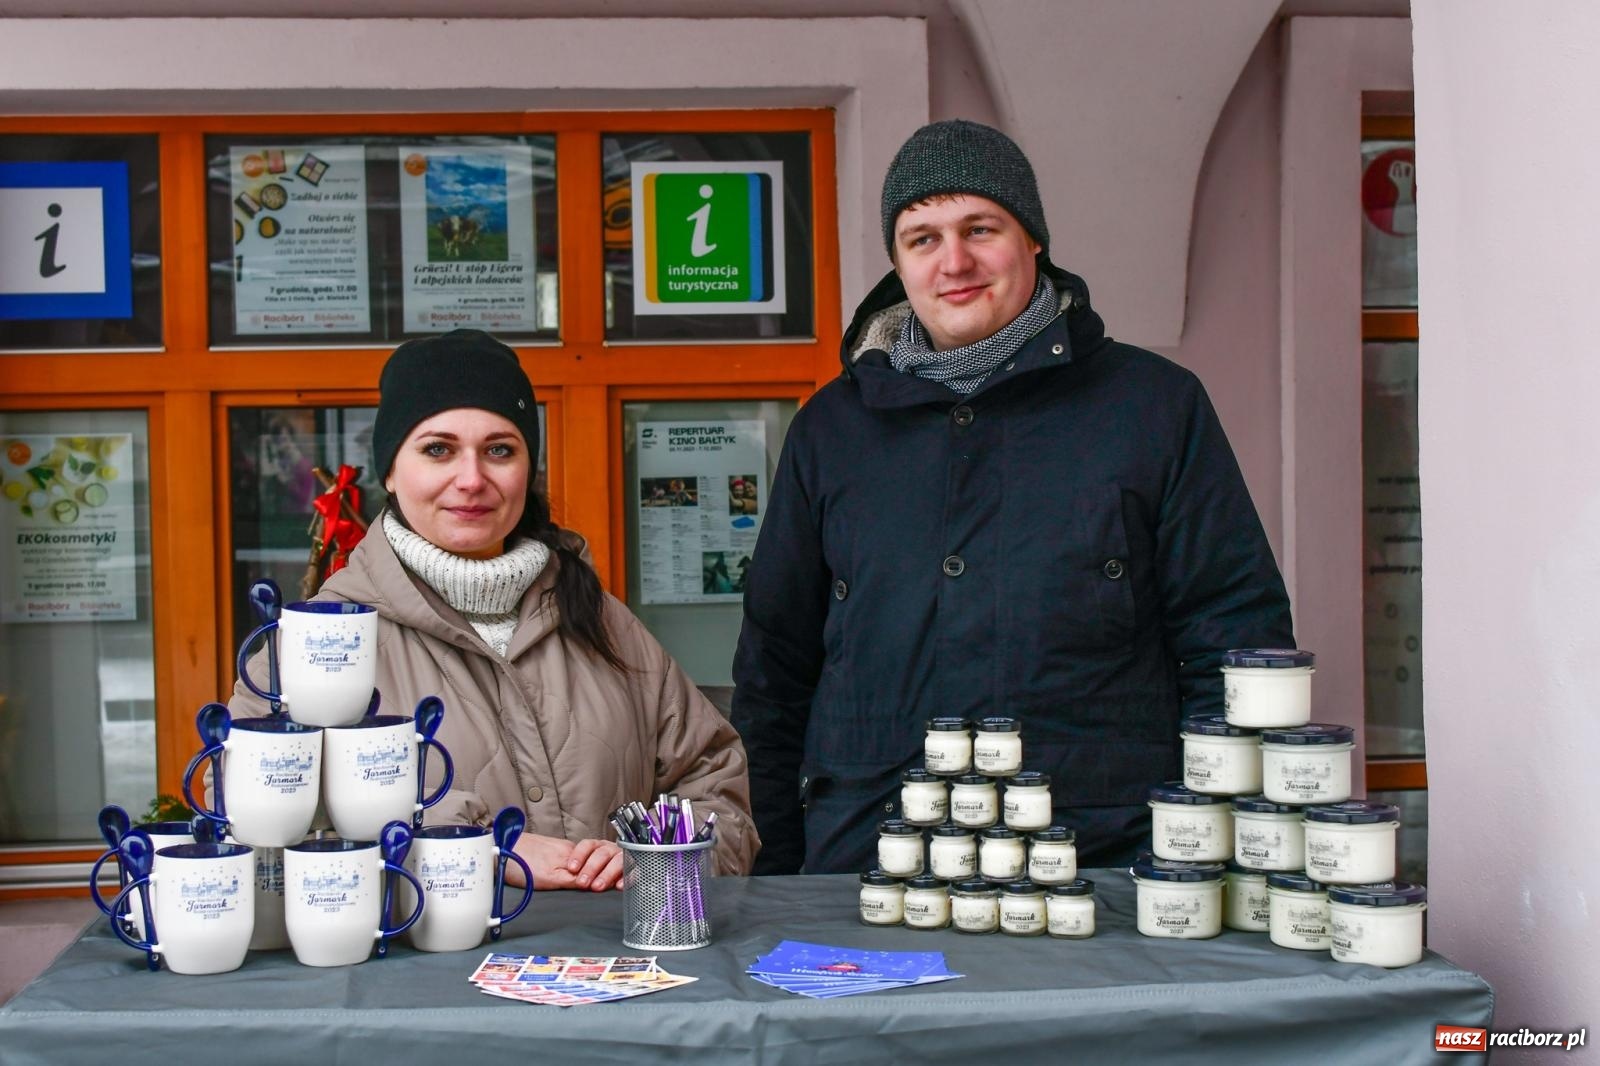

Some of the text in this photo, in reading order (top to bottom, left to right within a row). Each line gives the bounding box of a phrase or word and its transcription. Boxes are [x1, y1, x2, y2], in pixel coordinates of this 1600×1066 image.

[668, 264, 739, 278] informacja
[668, 280, 739, 293] turystyczna
[668, 426, 725, 435] REPERTUAR
[668, 435, 737, 445] KINO BAŁTYK
[17, 531, 117, 546] EKOkosmetyki
[309, 653, 349, 665] Jarmark
[363, 765, 401, 781] Jarmark
[264, 773, 303, 786] Jarmark
[1285, 781, 1321, 791] Jarmark
[954, 801, 984, 811] Jarmark
[1168, 839, 1201, 849] Jarmark
[1240, 847, 1270, 858] Jarmark
[1310, 856, 1339, 868] Jarmark
[426, 878, 465, 891] Jarmark
[307, 892, 348, 905] Jarmark
[186, 898, 228, 912] Jarmark
[1004, 912, 1035, 922] Jarmark
[1156, 917, 1190, 927] Jarmark
[1290, 924, 1326, 934] Jarmark
